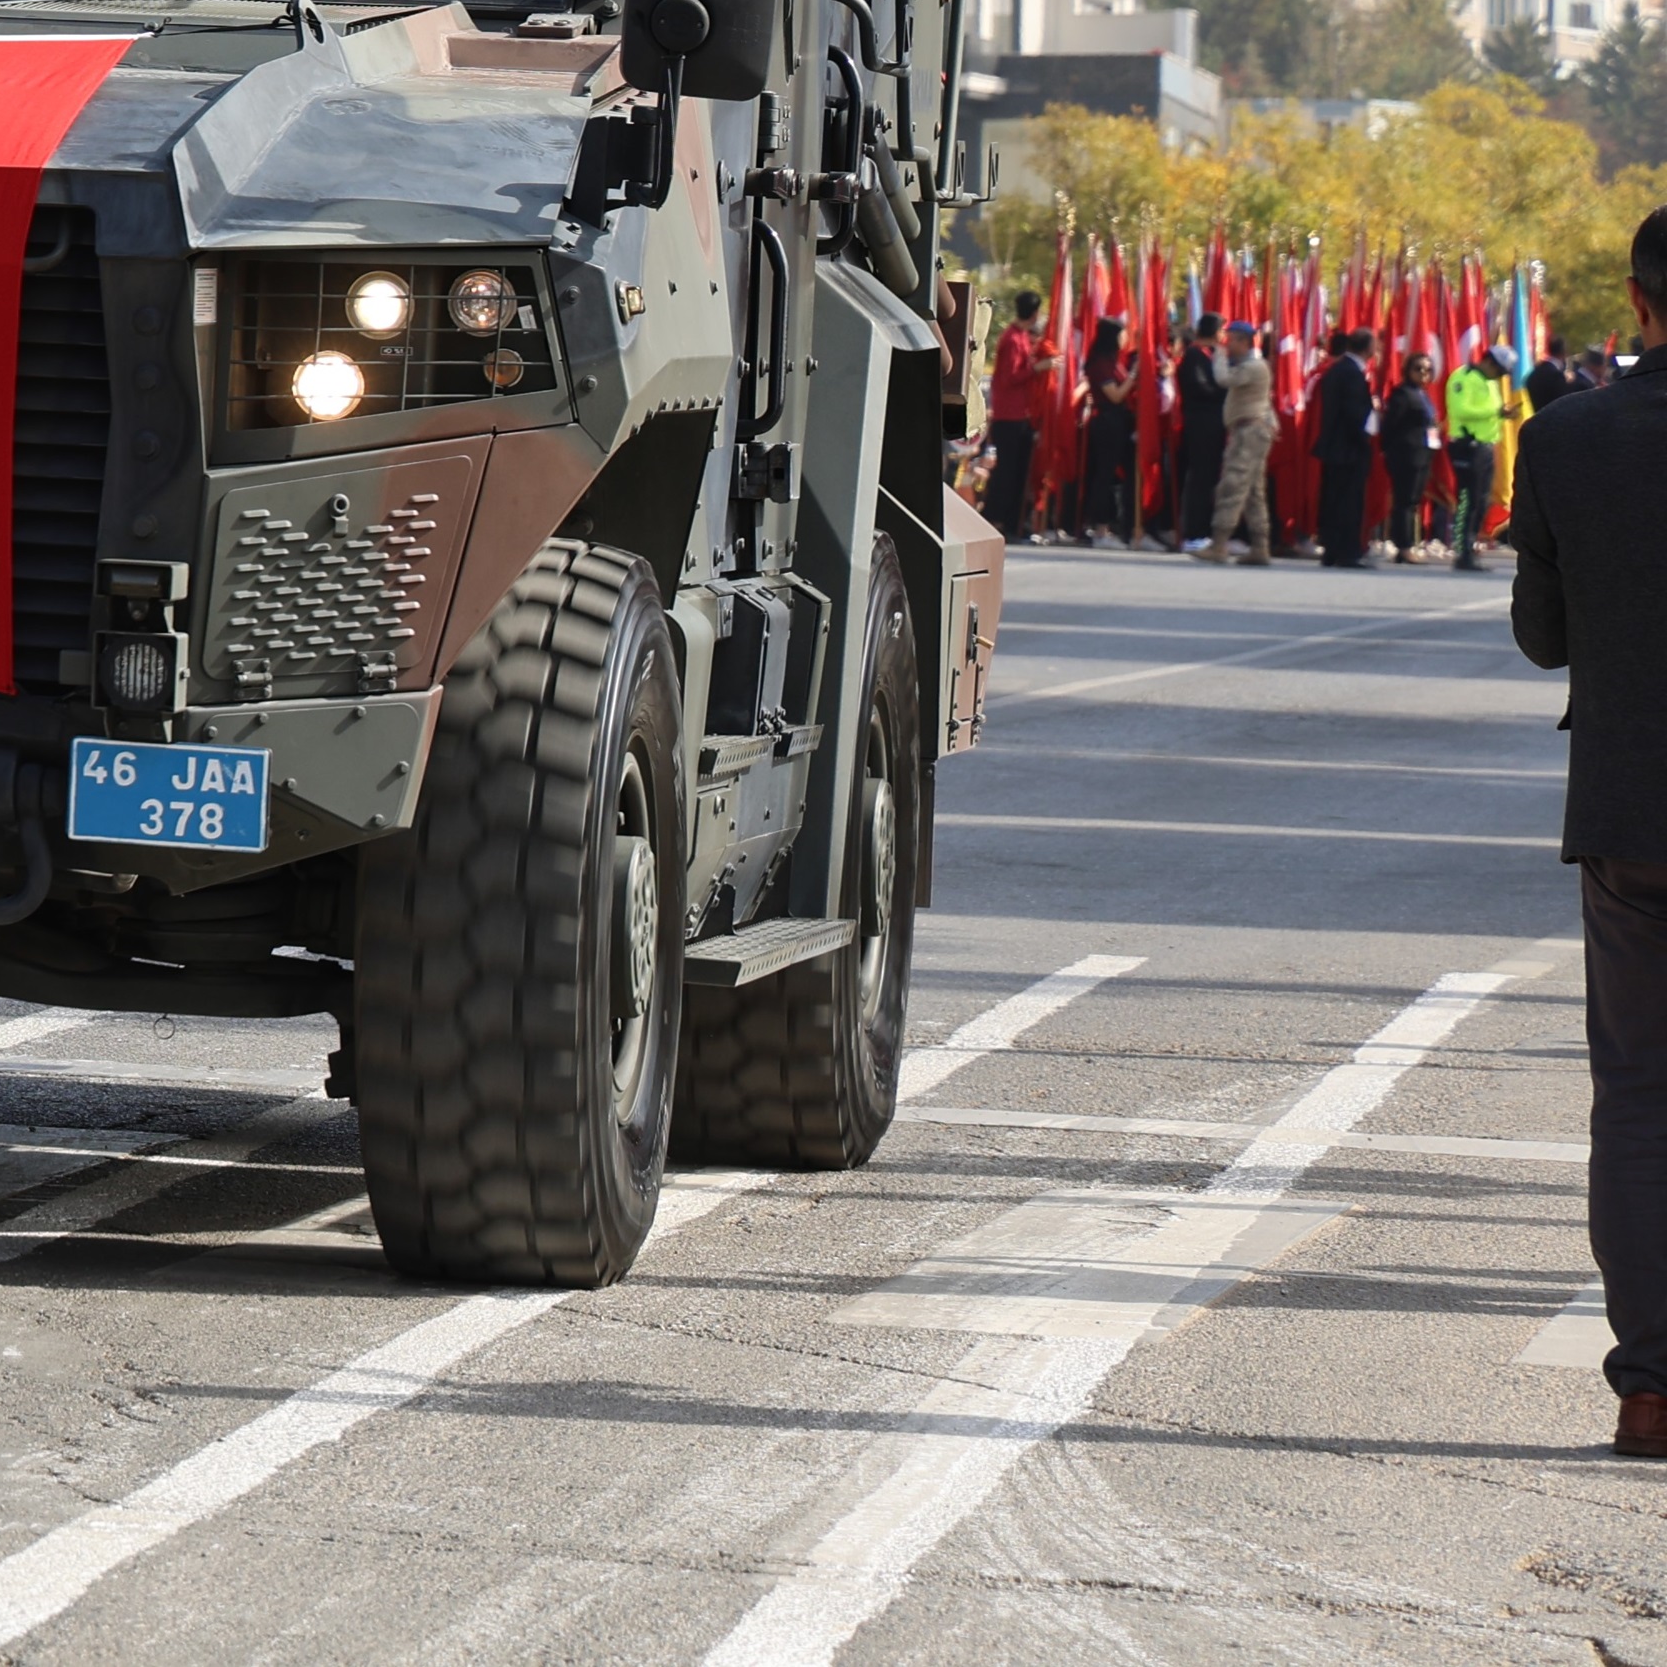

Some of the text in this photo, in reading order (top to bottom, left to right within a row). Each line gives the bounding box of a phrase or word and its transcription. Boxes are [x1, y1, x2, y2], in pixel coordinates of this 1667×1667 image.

[83, 750, 256, 795] 46 JAA
[139, 798, 225, 840] 378
